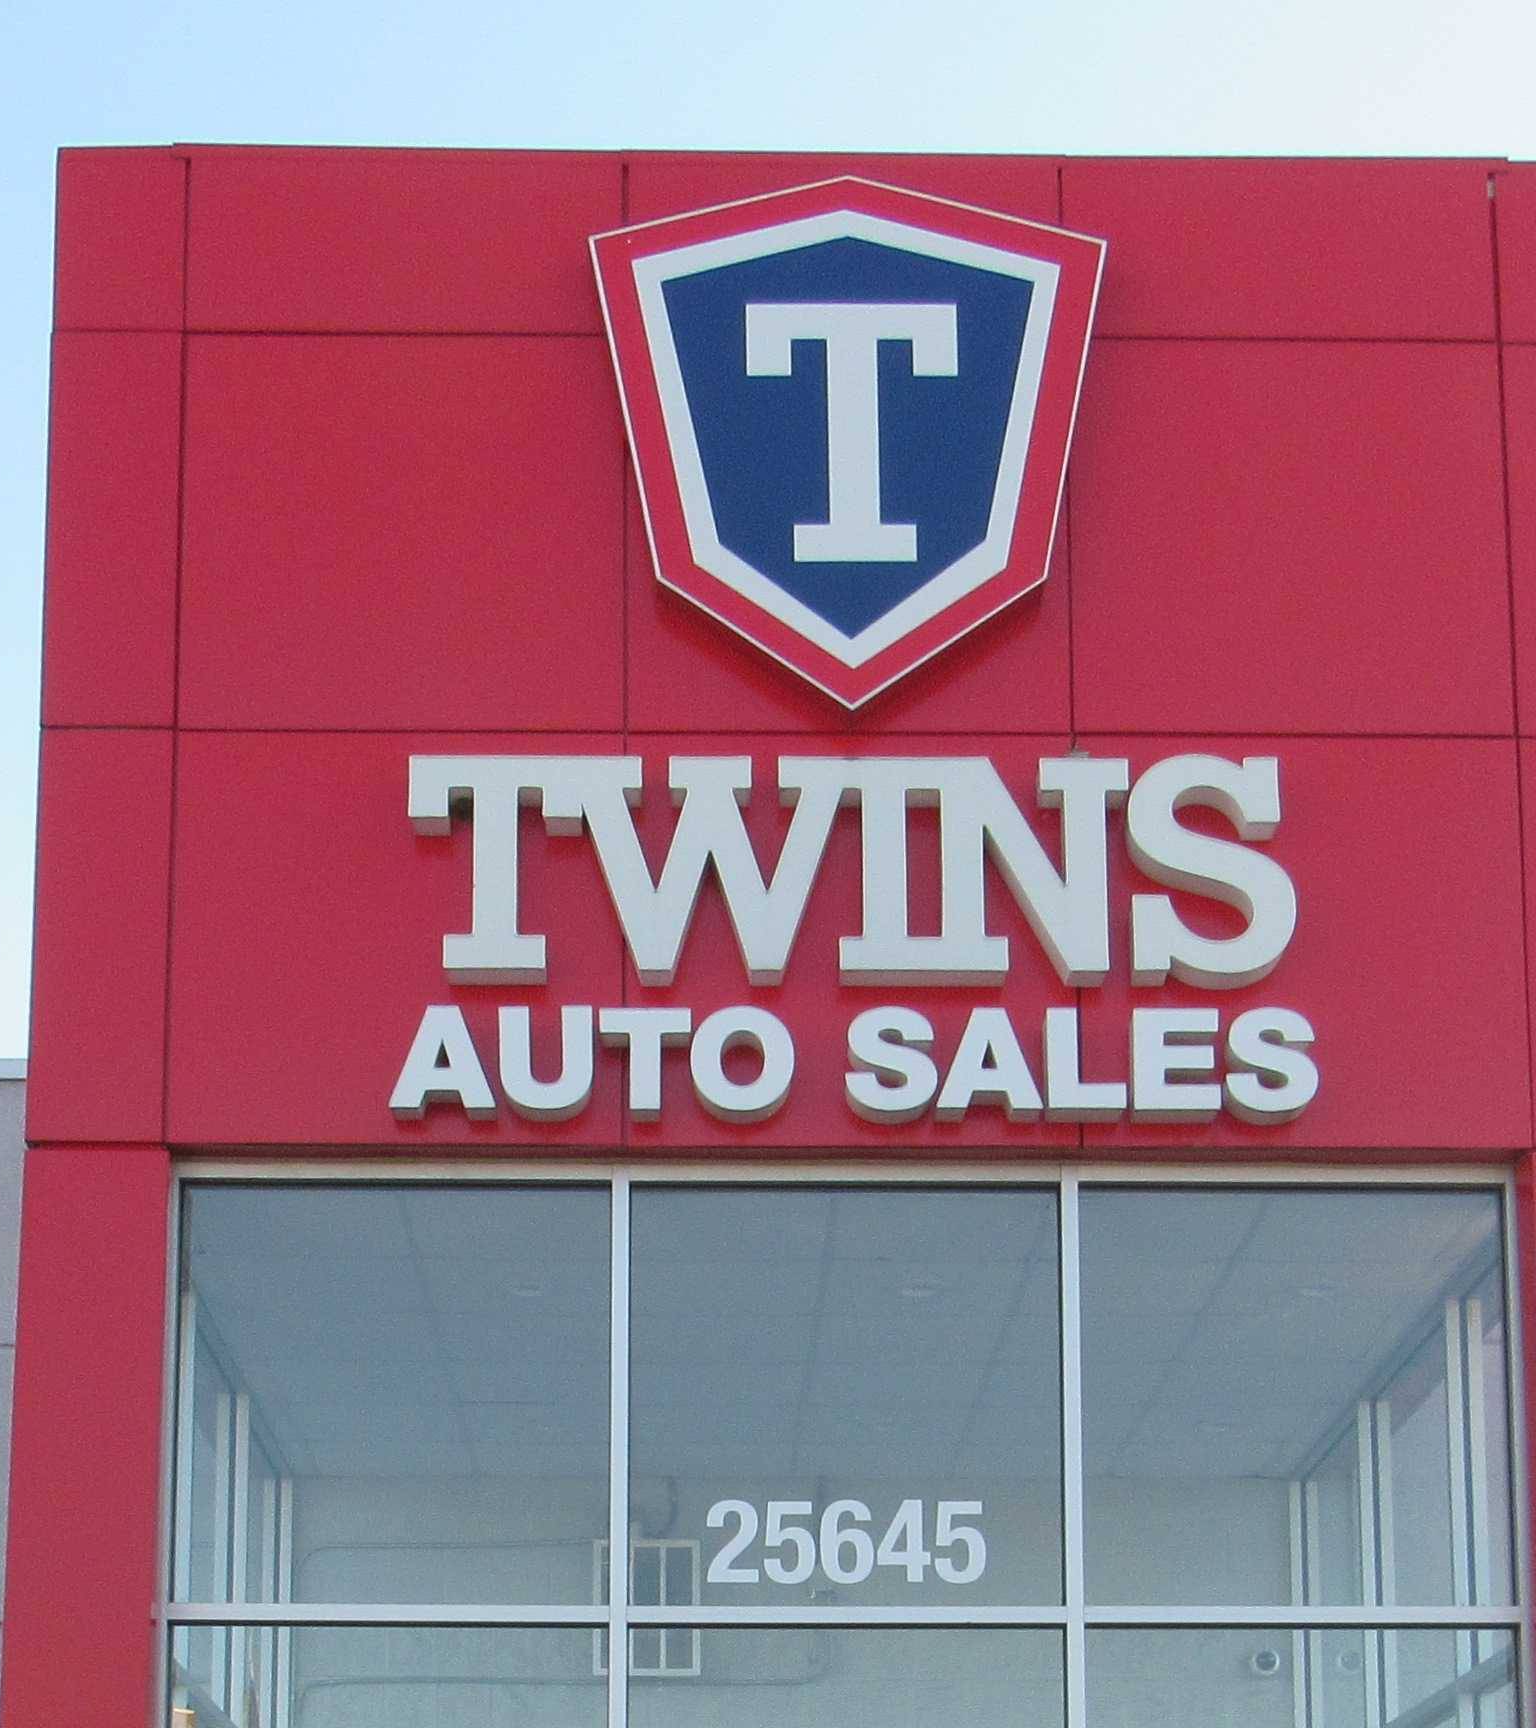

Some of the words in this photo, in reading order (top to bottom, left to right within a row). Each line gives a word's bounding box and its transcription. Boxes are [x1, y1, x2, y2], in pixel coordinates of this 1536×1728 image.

[746, 303, 958, 562] T
[407, 754, 1296, 988] TWINS
[390, 1004, 795, 1123] AUTO
[844, 1005, 1320, 1123] SALES
[705, 1498, 987, 1586] 25645
